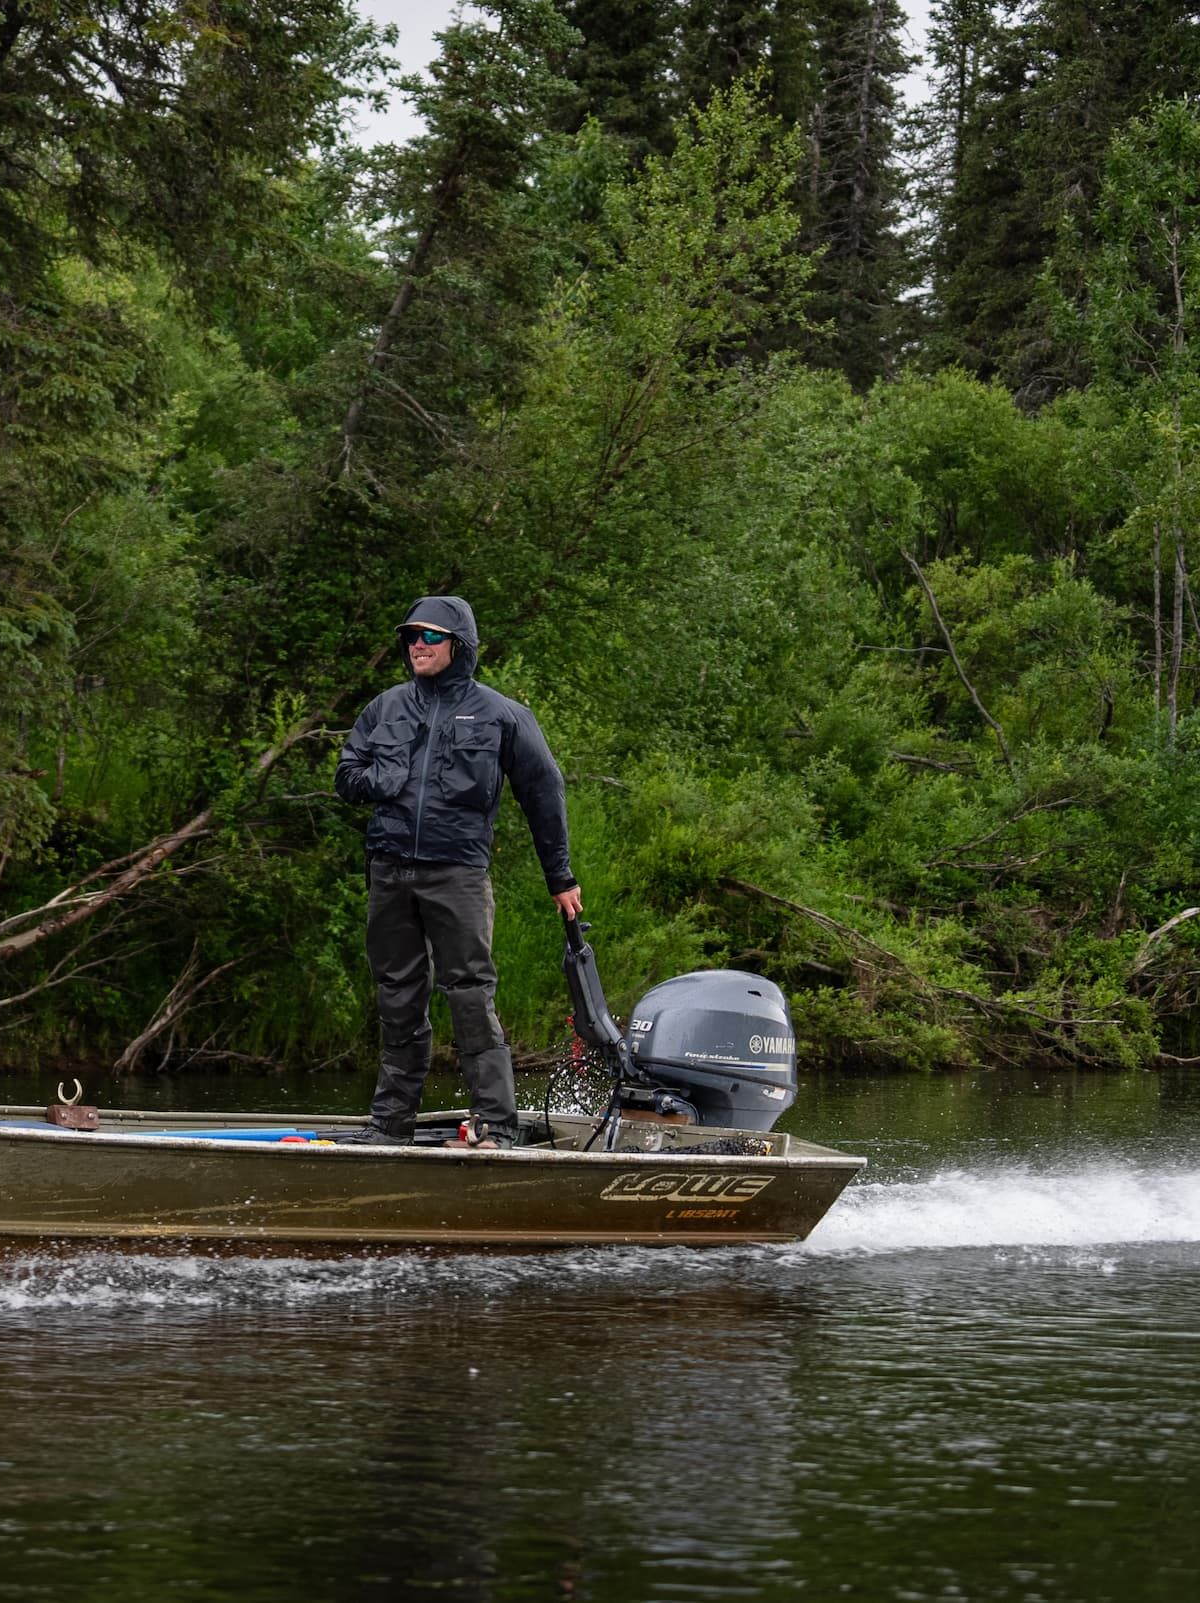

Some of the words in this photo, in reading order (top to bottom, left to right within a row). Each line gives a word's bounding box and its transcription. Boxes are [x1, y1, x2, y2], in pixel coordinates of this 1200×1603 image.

[630, 1019, 654, 1031] 30
[763, 1036, 795, 1053] YAMAHA
[599, 1172, 777, 1202] LOWE
